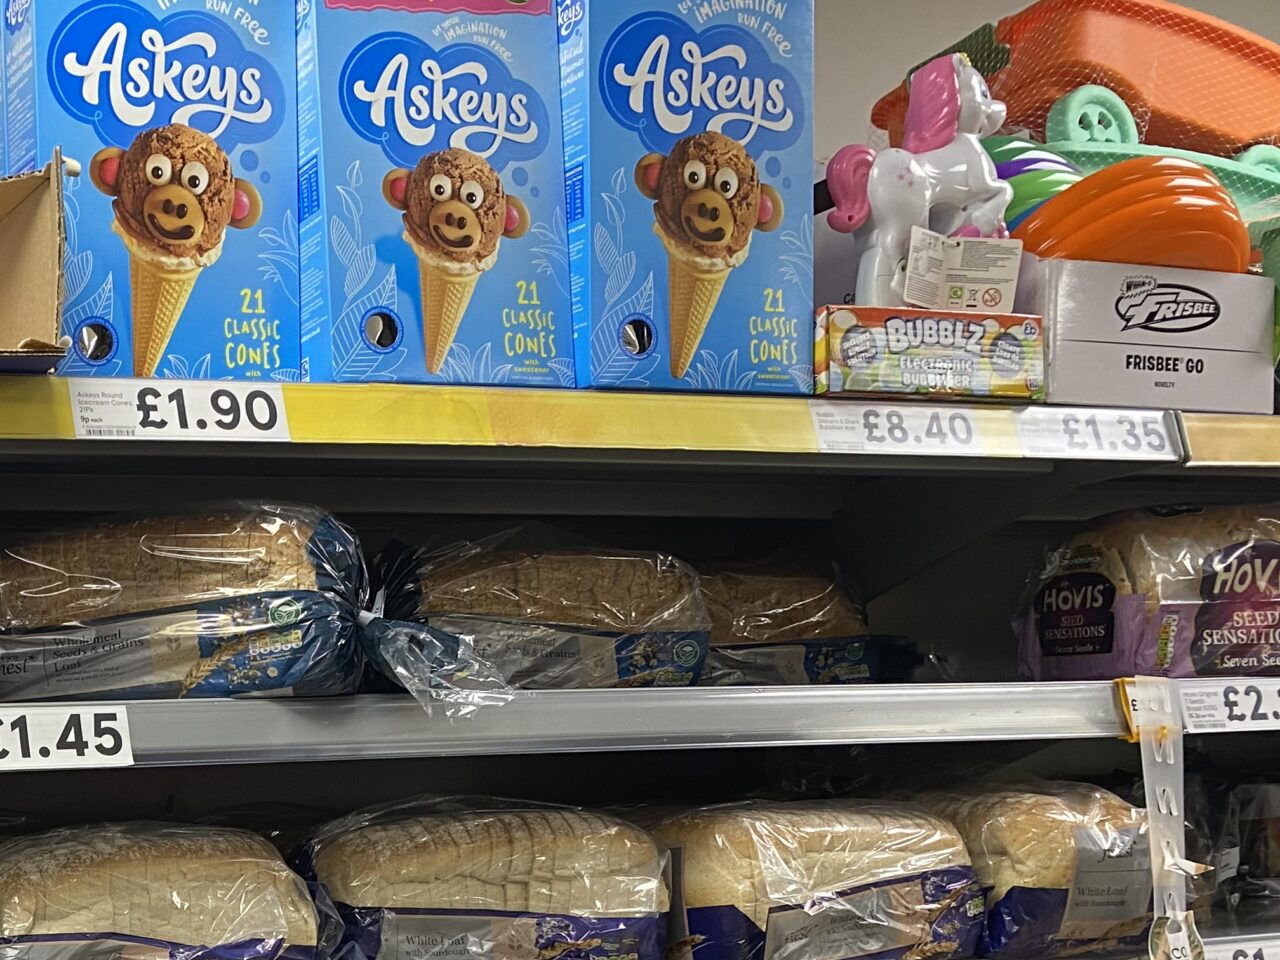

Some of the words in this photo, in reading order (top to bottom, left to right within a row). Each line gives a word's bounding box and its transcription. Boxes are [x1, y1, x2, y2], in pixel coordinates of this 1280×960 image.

[64, 22, 271, 138] Askeys
[613, 34, 793, 142] Askeys
[354, 53, 538, 158] Askeys
[240, 288, 265, 313] 21
[516, 281, 540, 304] 21
[764, 288, 784, 312] 21
[1121, 292, 1216, 332] FRISBEE
[504, 331, 556, 357] CONES
[885, 317, 985, 354] BUBBLZ
[225, 342, 280, 368] CONES
[751, 339, 797, 365] CONES
[1186, 358, 1204, 374] GO
[137, 387, 278, 431] £1.90
[863, 409, 973, 445] £8.40
[1063, 413, 1165, 452] £1.35
[1043, 584, 1104, 611] HOVIS
[52, 648, 87, 659] Seeds
[1223, 686, 1280, 721] £2.
